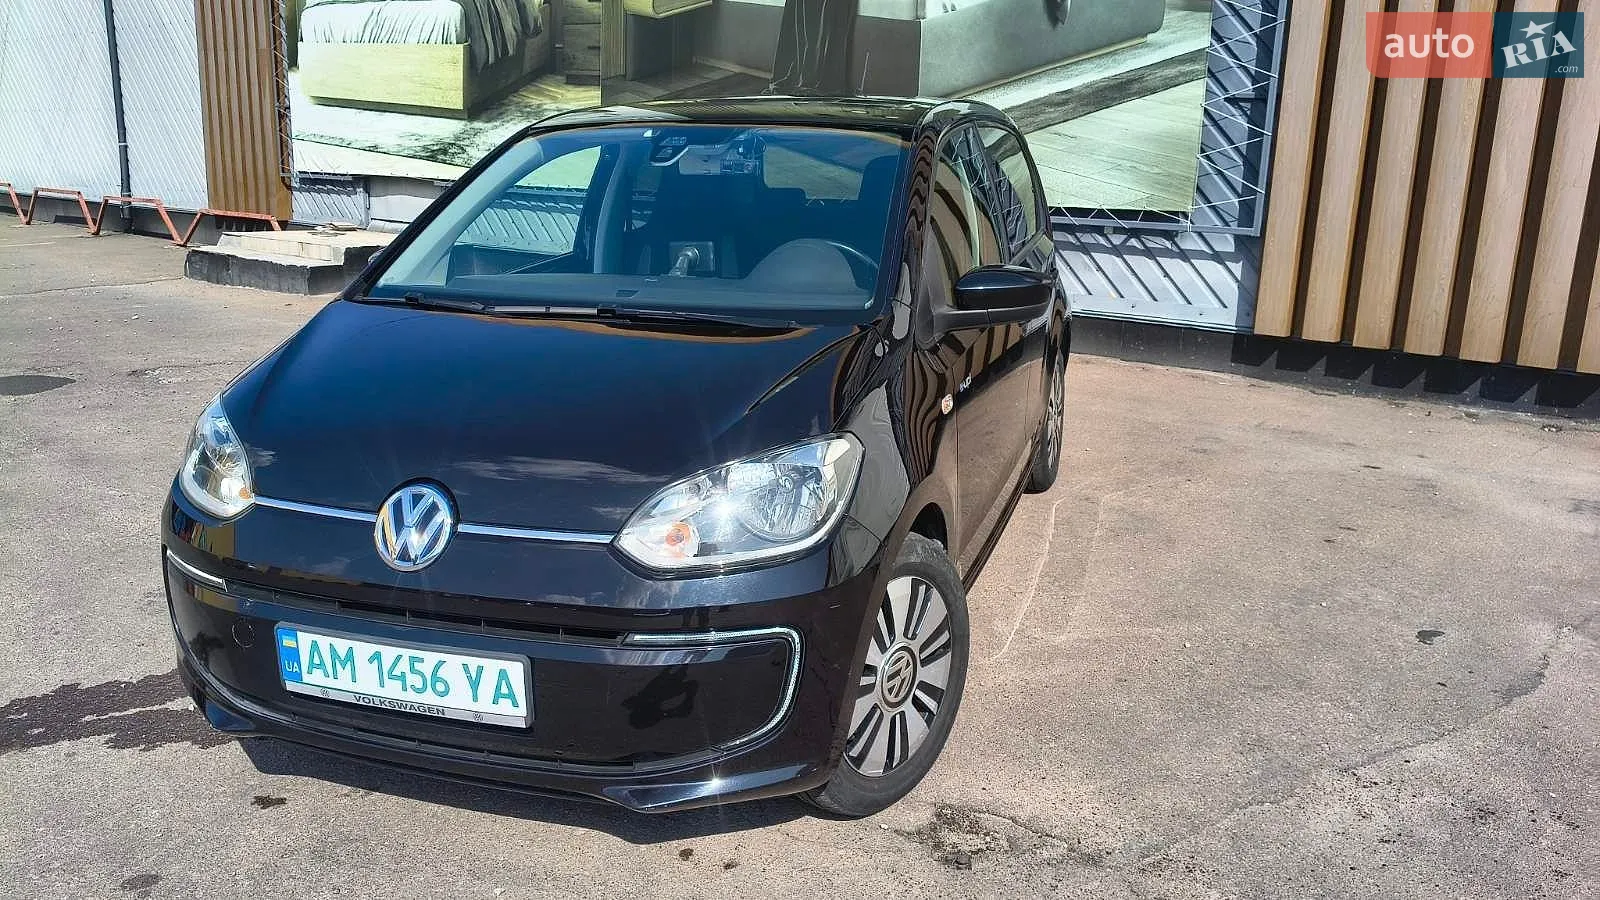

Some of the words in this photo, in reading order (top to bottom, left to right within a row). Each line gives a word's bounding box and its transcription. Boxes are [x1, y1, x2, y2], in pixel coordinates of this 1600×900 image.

[285, 660, 300, 673] UA
[307, 639, 357, 683] AM
[367, 650, 450, 698] 1456
[461, 663, 519, 708] YA
[353, 694, 446, 716] VOLKSWAGEN
